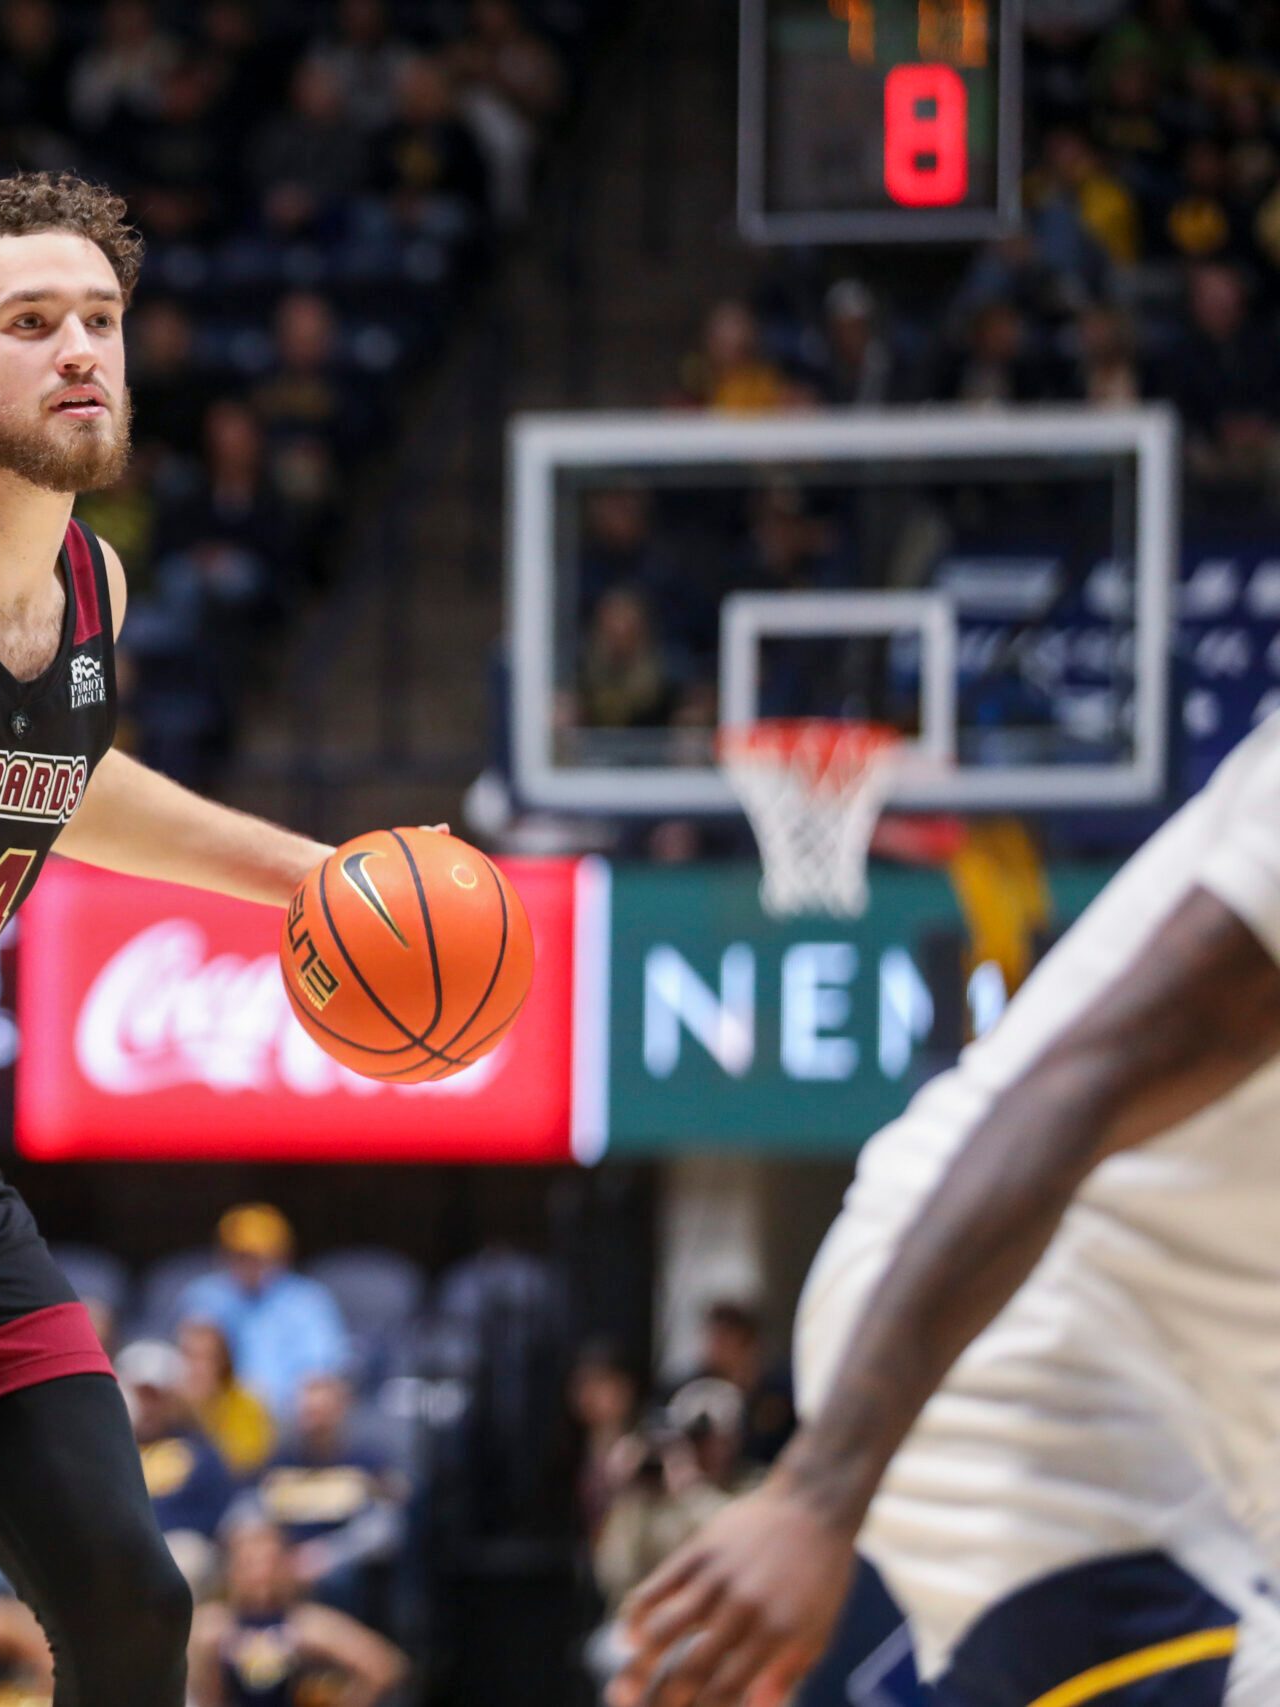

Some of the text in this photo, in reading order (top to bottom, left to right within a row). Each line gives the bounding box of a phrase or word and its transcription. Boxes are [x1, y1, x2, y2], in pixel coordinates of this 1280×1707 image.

[884, 62, 968, 208] 8
[71, 677, 104, 697] PATRIOT
[72, 689, 106, 709] LEAGUE
